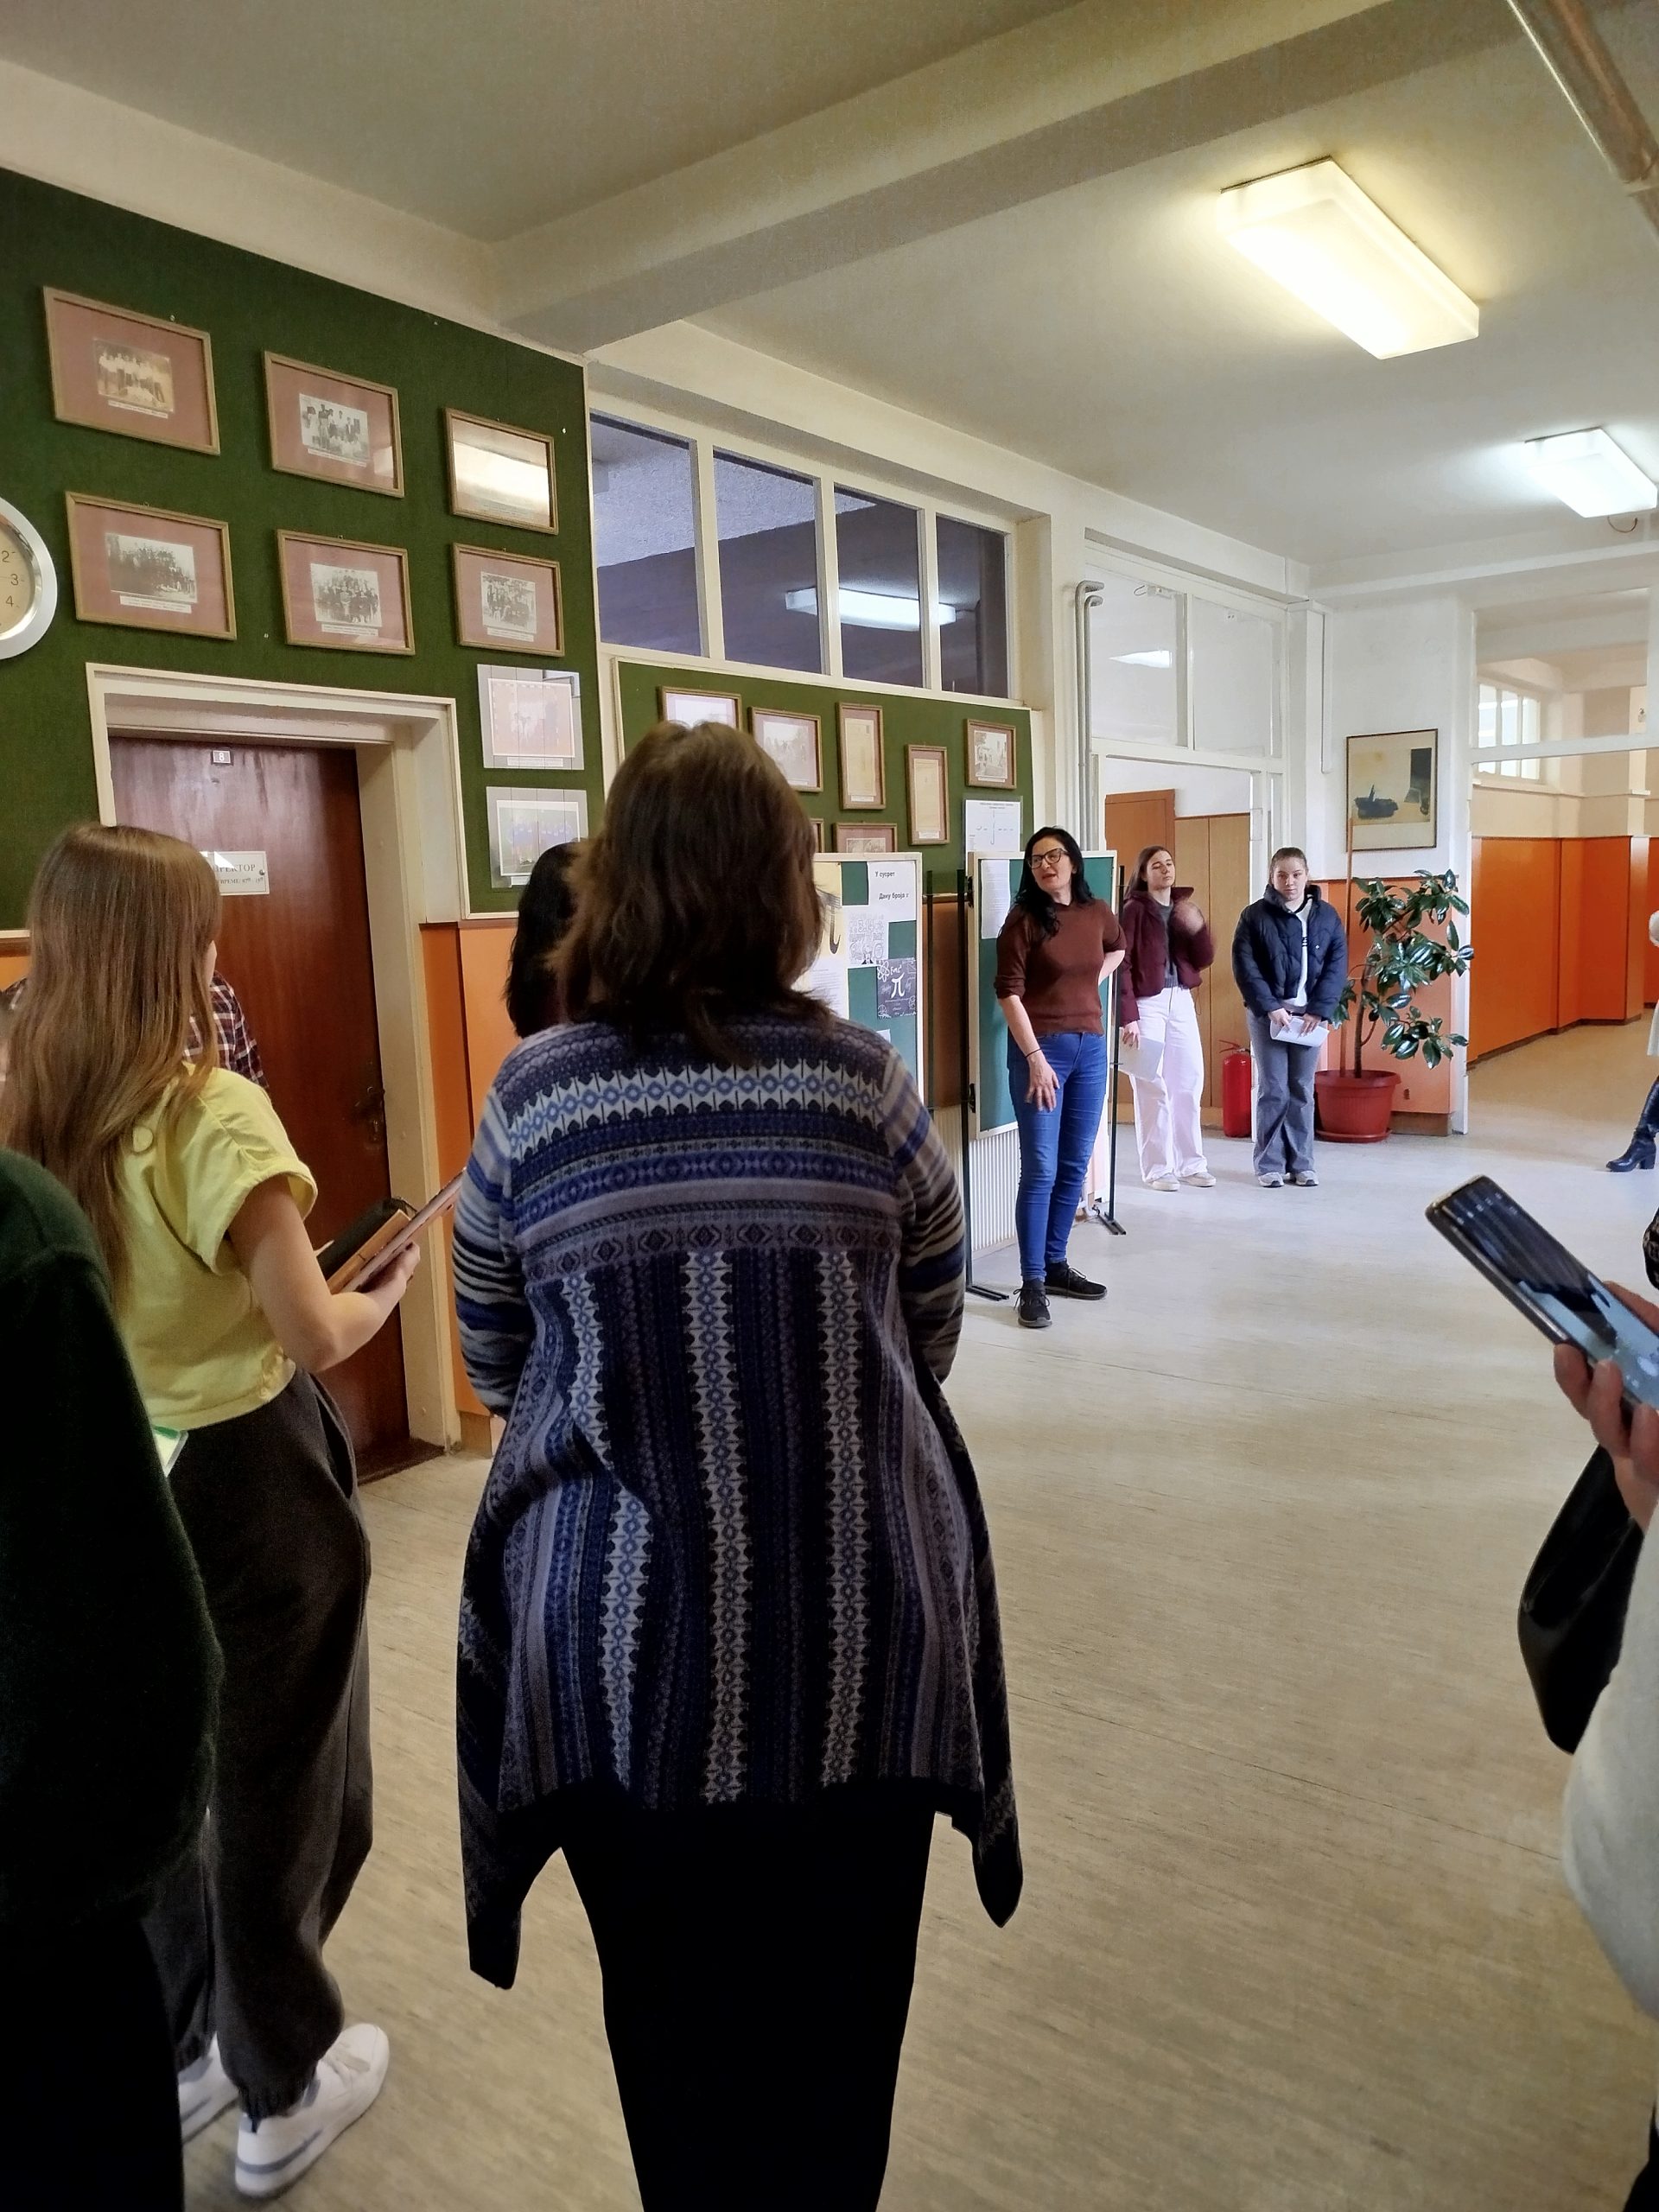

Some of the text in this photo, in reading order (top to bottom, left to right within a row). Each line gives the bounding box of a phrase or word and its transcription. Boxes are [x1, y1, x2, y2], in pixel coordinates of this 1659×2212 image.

[2, 550, 10, 563] 2
[10, 573, 19, 586] 3
[5, 595, 14, 607] 4
[219, 752, 225, 761] 8
